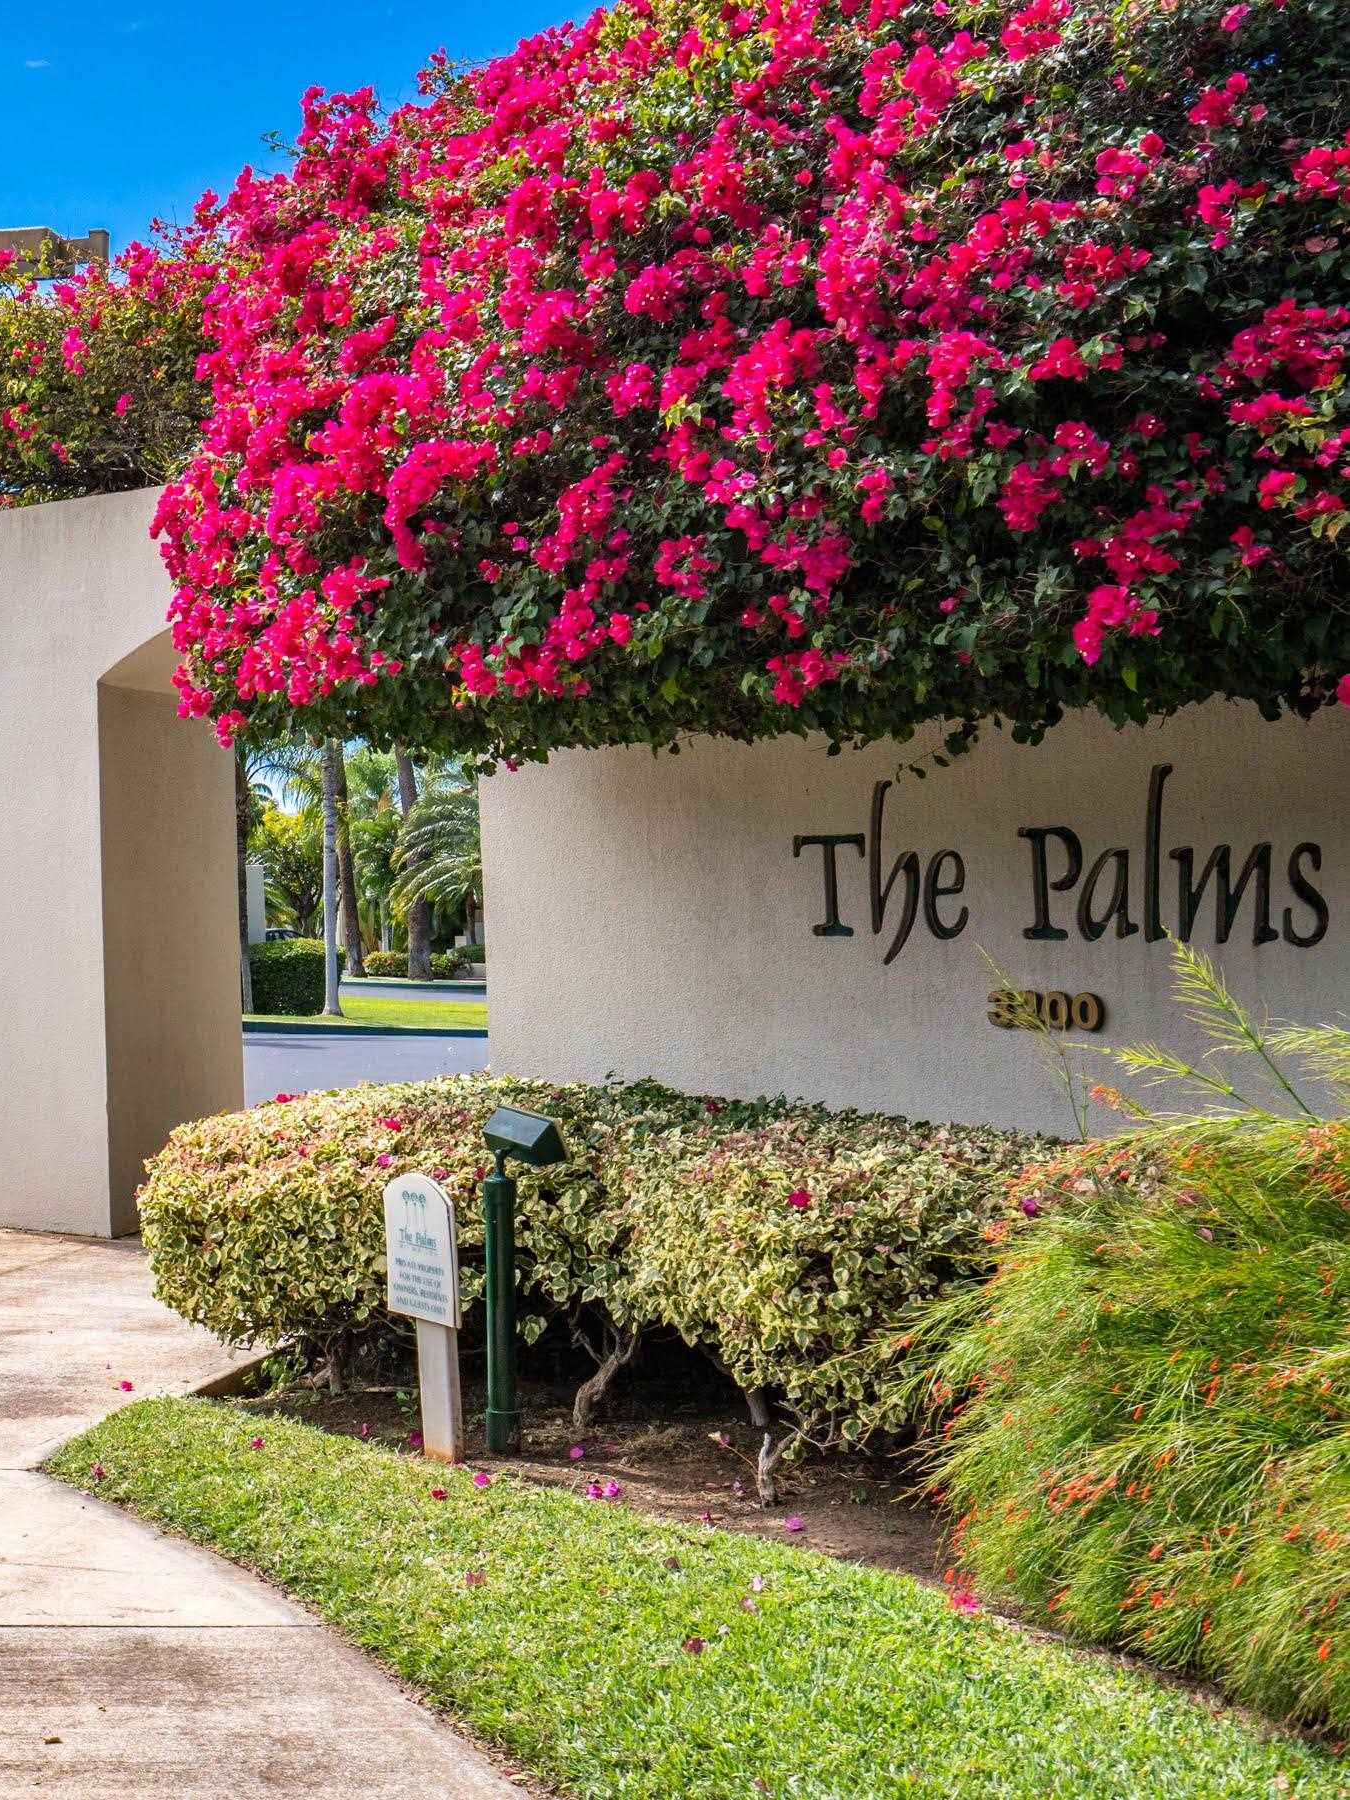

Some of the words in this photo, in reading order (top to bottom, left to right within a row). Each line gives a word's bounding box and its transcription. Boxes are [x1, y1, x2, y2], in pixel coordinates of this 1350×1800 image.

[792, 780, 969, 966] The
[1017, 763, 1329, 948] Palms
[399, 1228, 413, 1242] The
[415, 1231, 438, 1247] Palms
